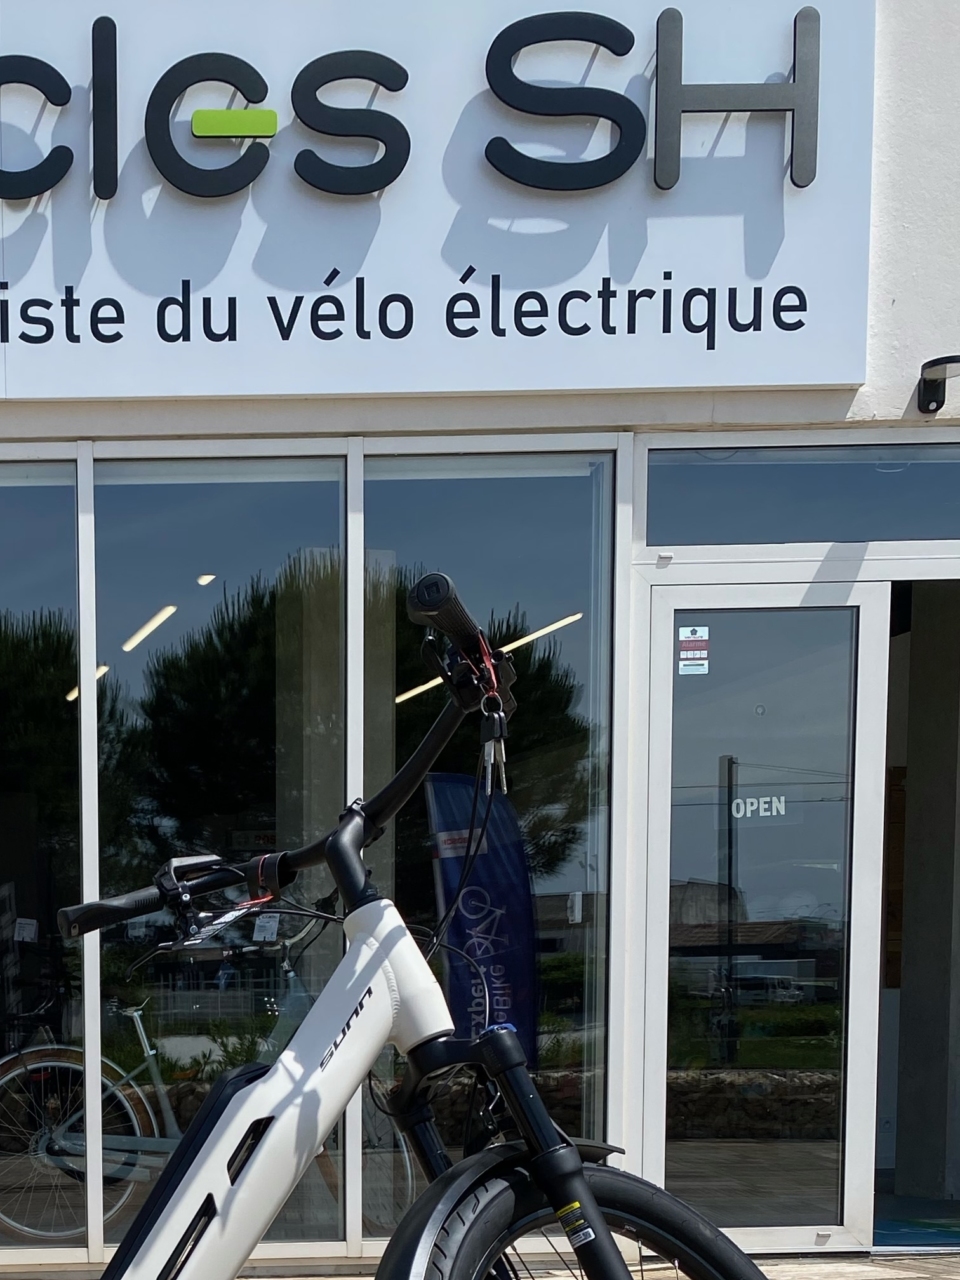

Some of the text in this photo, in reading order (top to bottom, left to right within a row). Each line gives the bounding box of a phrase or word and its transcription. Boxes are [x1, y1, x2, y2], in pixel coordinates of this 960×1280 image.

[485, 7, 820, 200] SH
[157, 279, 237, 343] du
[267, 267, 414, 341] vélo
[446, 264, 808, 351] électrique
[731, 795, 786, 819] OPEN
